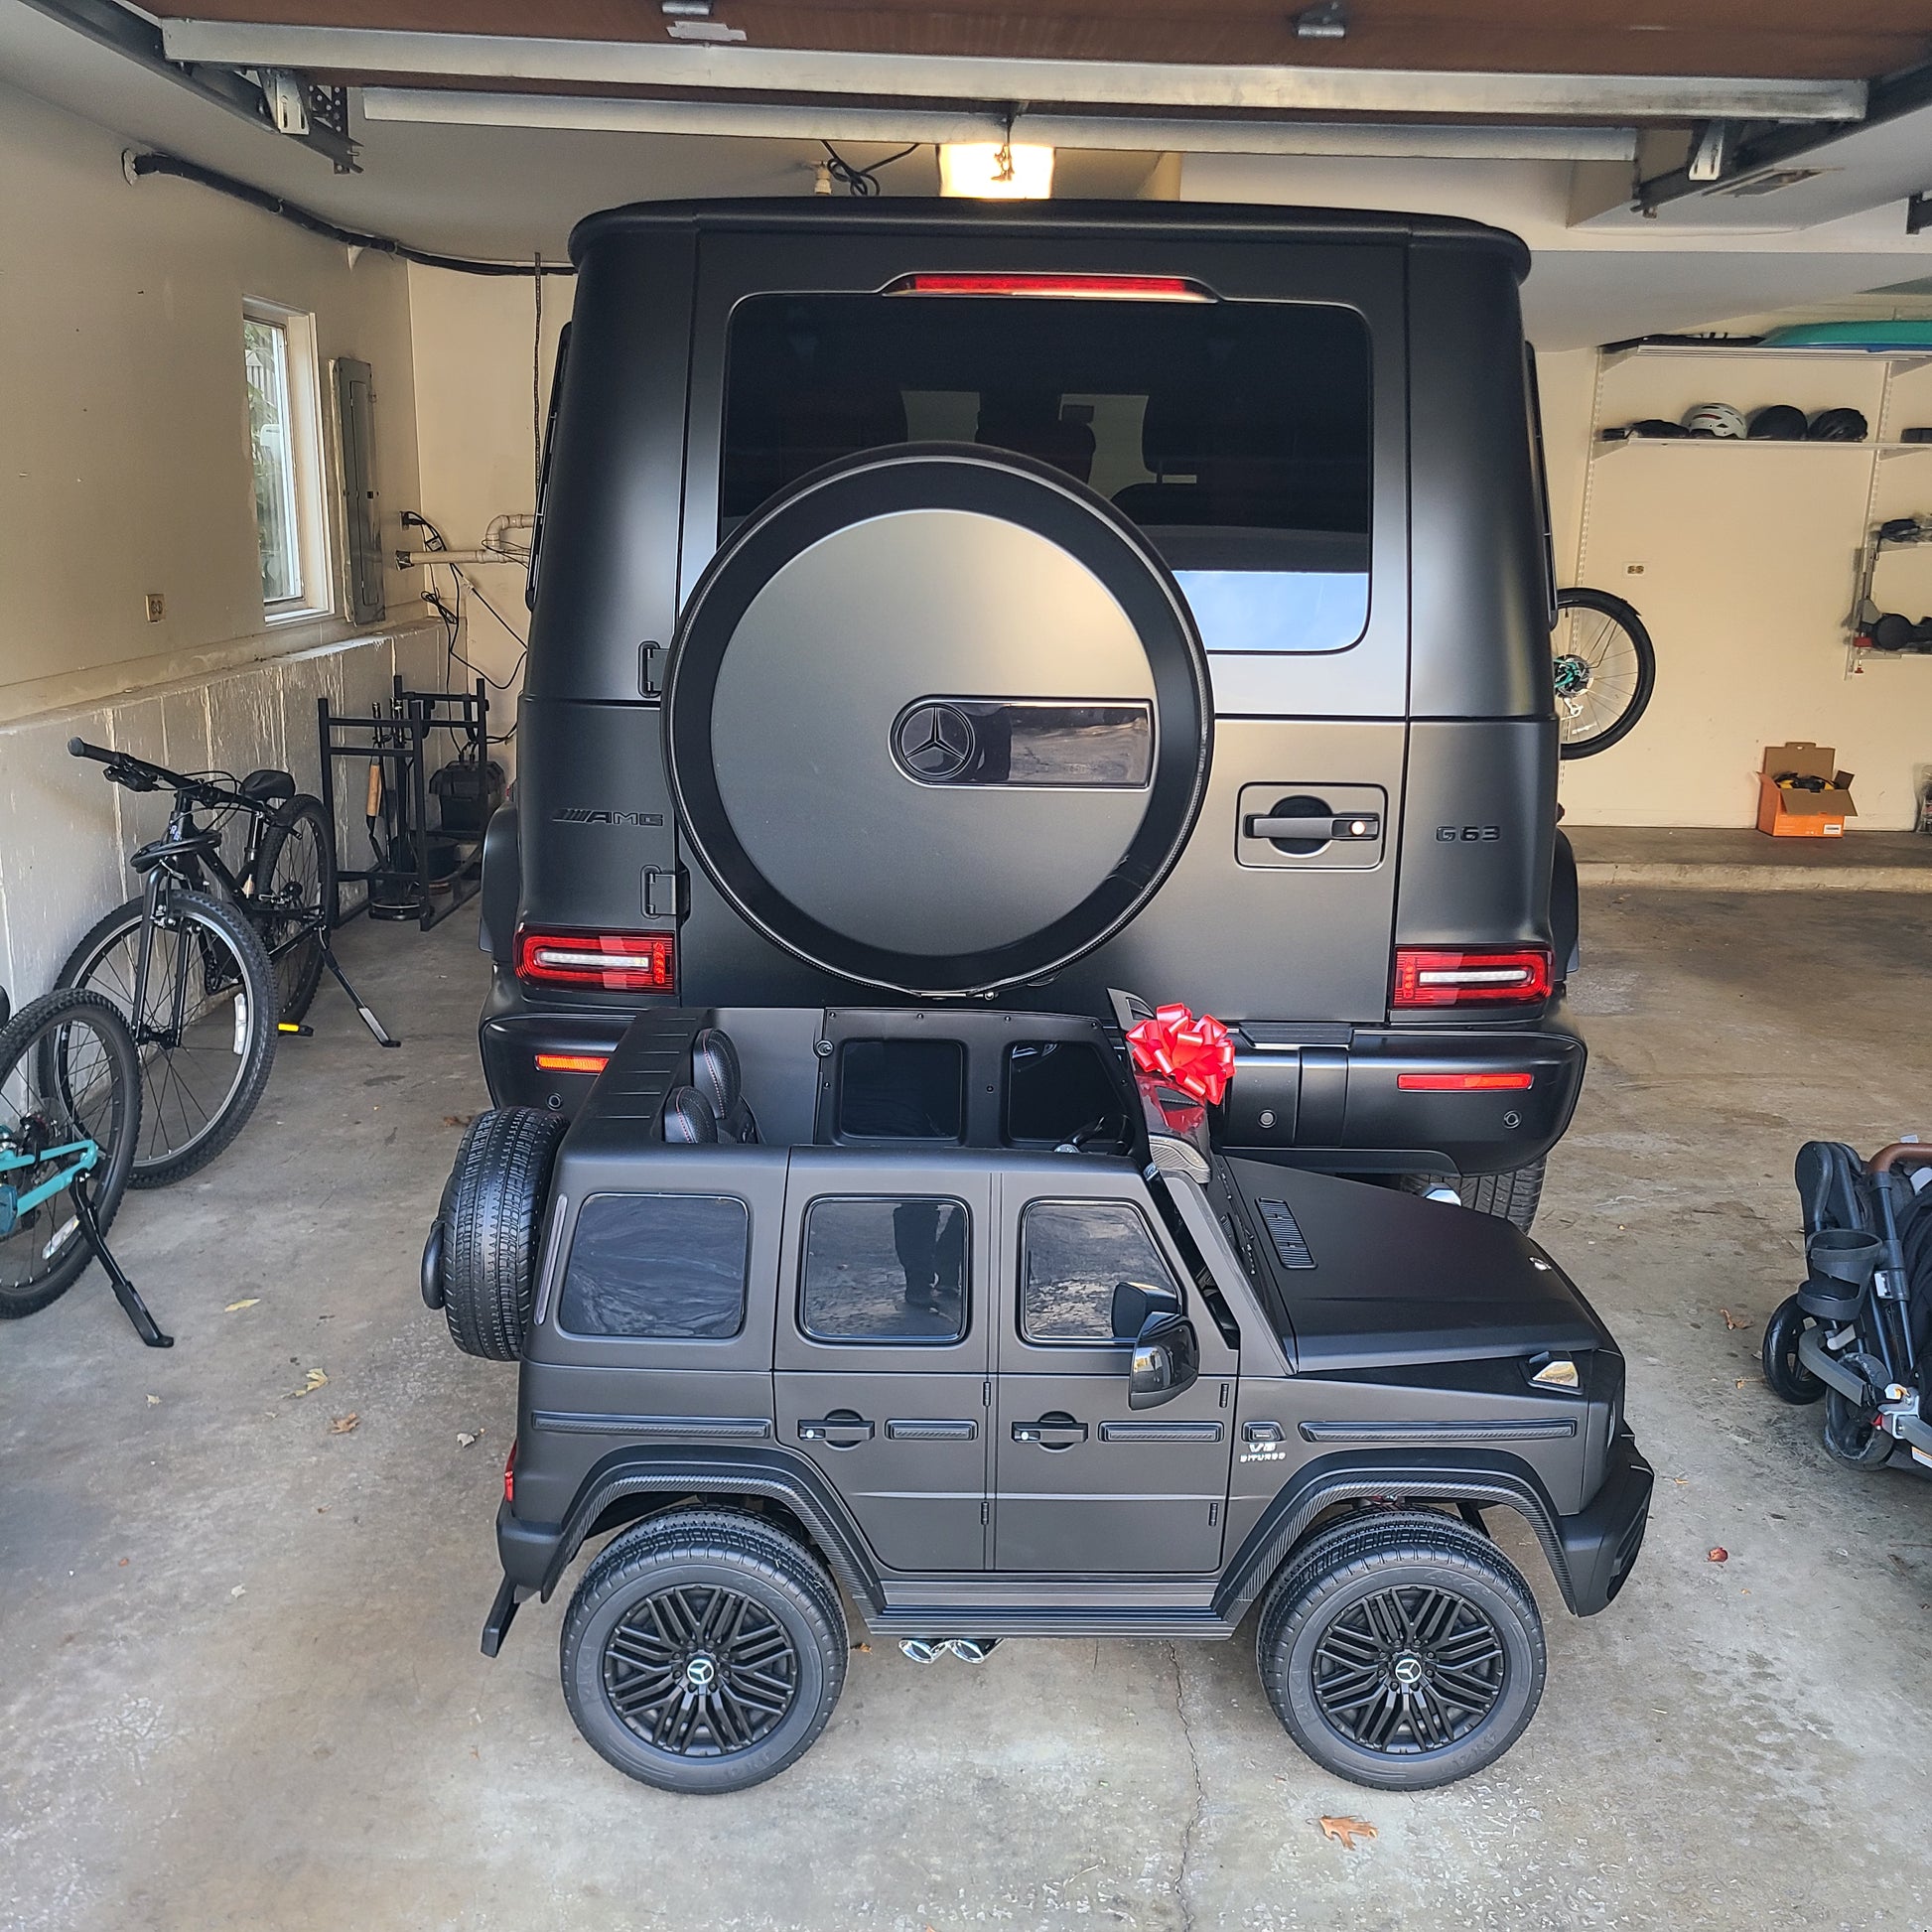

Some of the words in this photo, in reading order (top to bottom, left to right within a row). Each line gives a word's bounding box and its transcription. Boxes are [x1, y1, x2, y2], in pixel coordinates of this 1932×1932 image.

[583, 809, 664, 826] AMG
[1436, 826, 1500, 841] G63
[1249, 1443, 1276, 1452] V8
[1240, 1452, 1286, 1462] BITURBO
